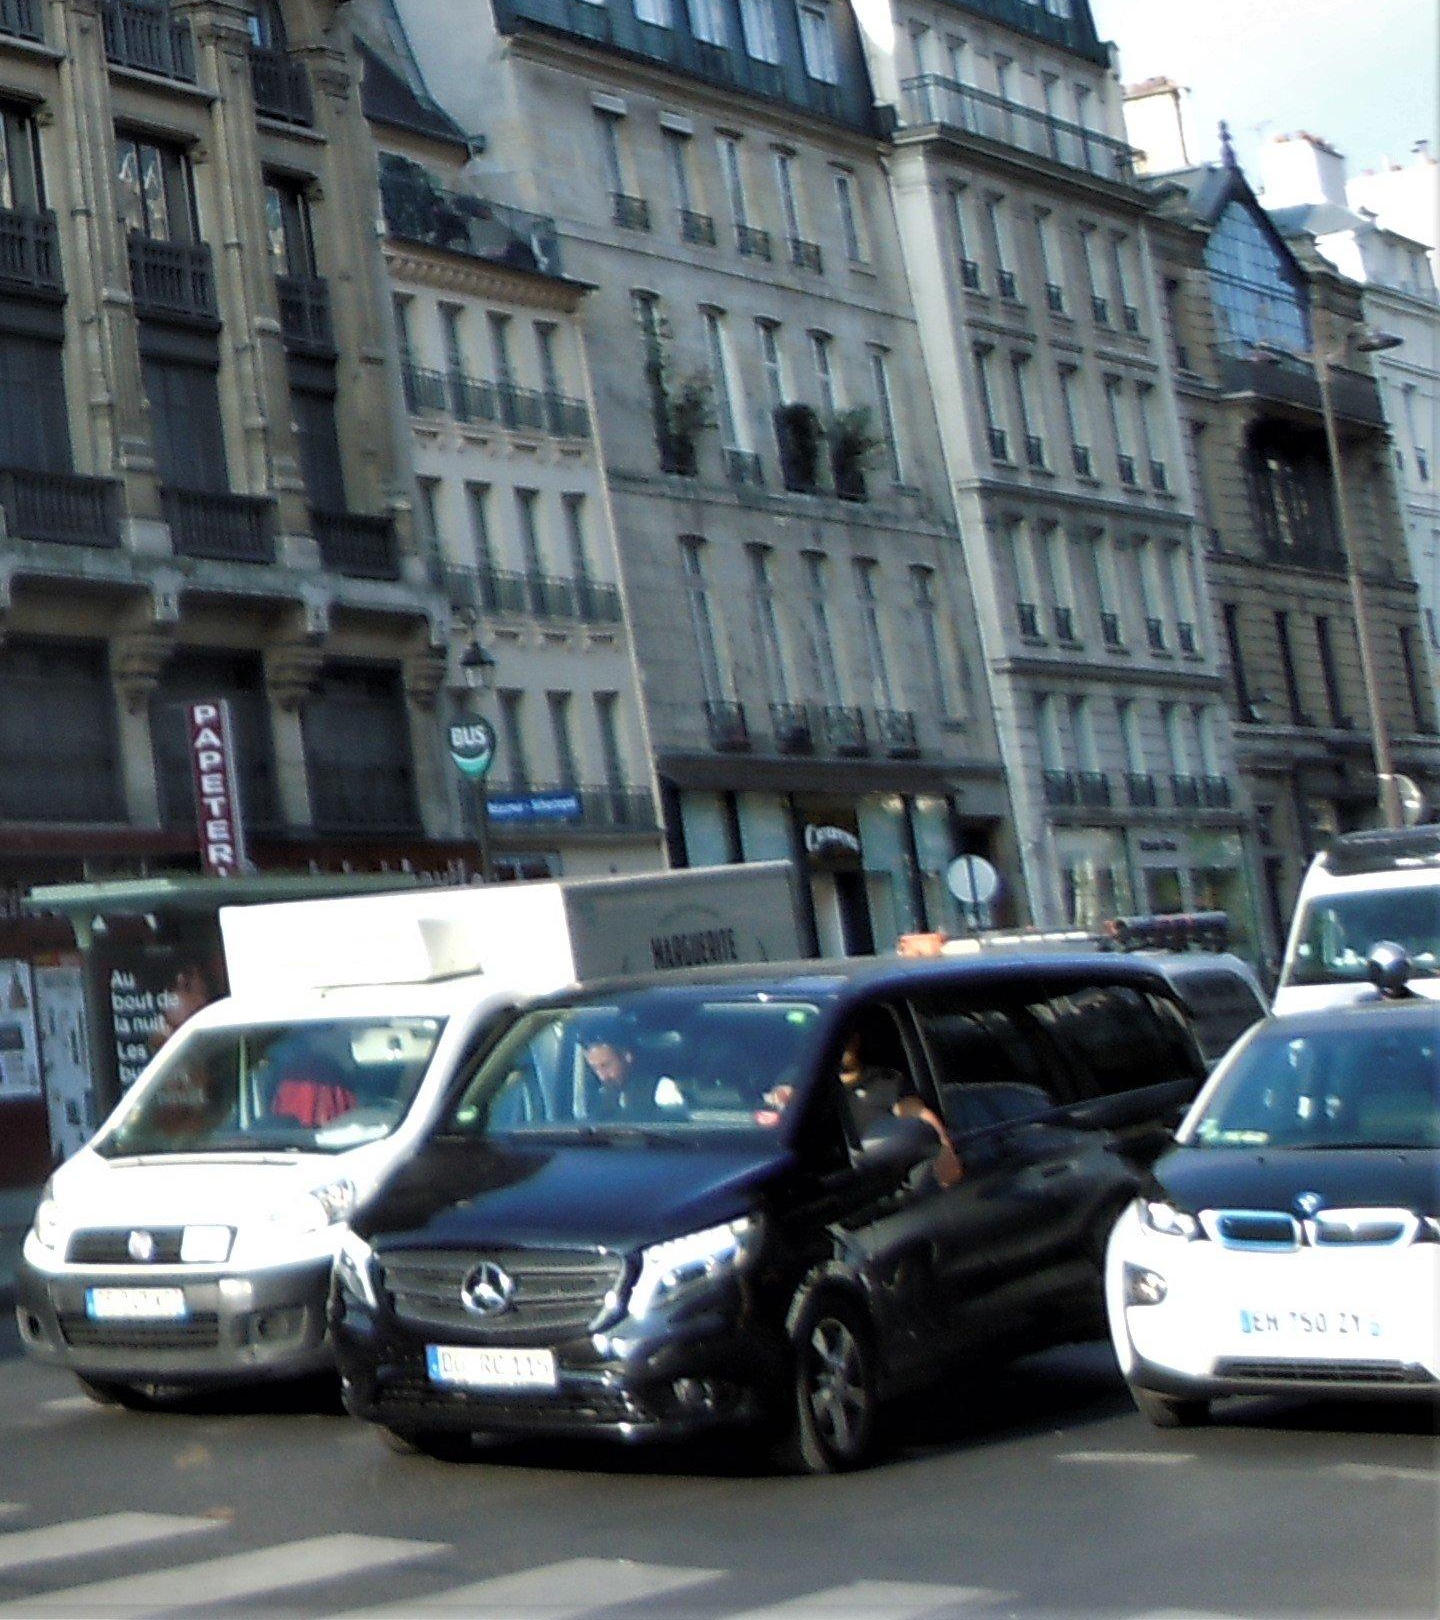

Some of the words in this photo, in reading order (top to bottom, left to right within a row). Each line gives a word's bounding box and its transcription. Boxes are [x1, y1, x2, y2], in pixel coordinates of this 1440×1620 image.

[450, 726, 487, 748] BUS
[193, 704, 234, 878] PAPETER
[111, 968, 135, 990] Au
[111, 991, 153, 1011] bout
[157, 989, 180, 1011] de
[114, 1013, 131, 1033] la
[117, 1041, 148, 1061] Les
